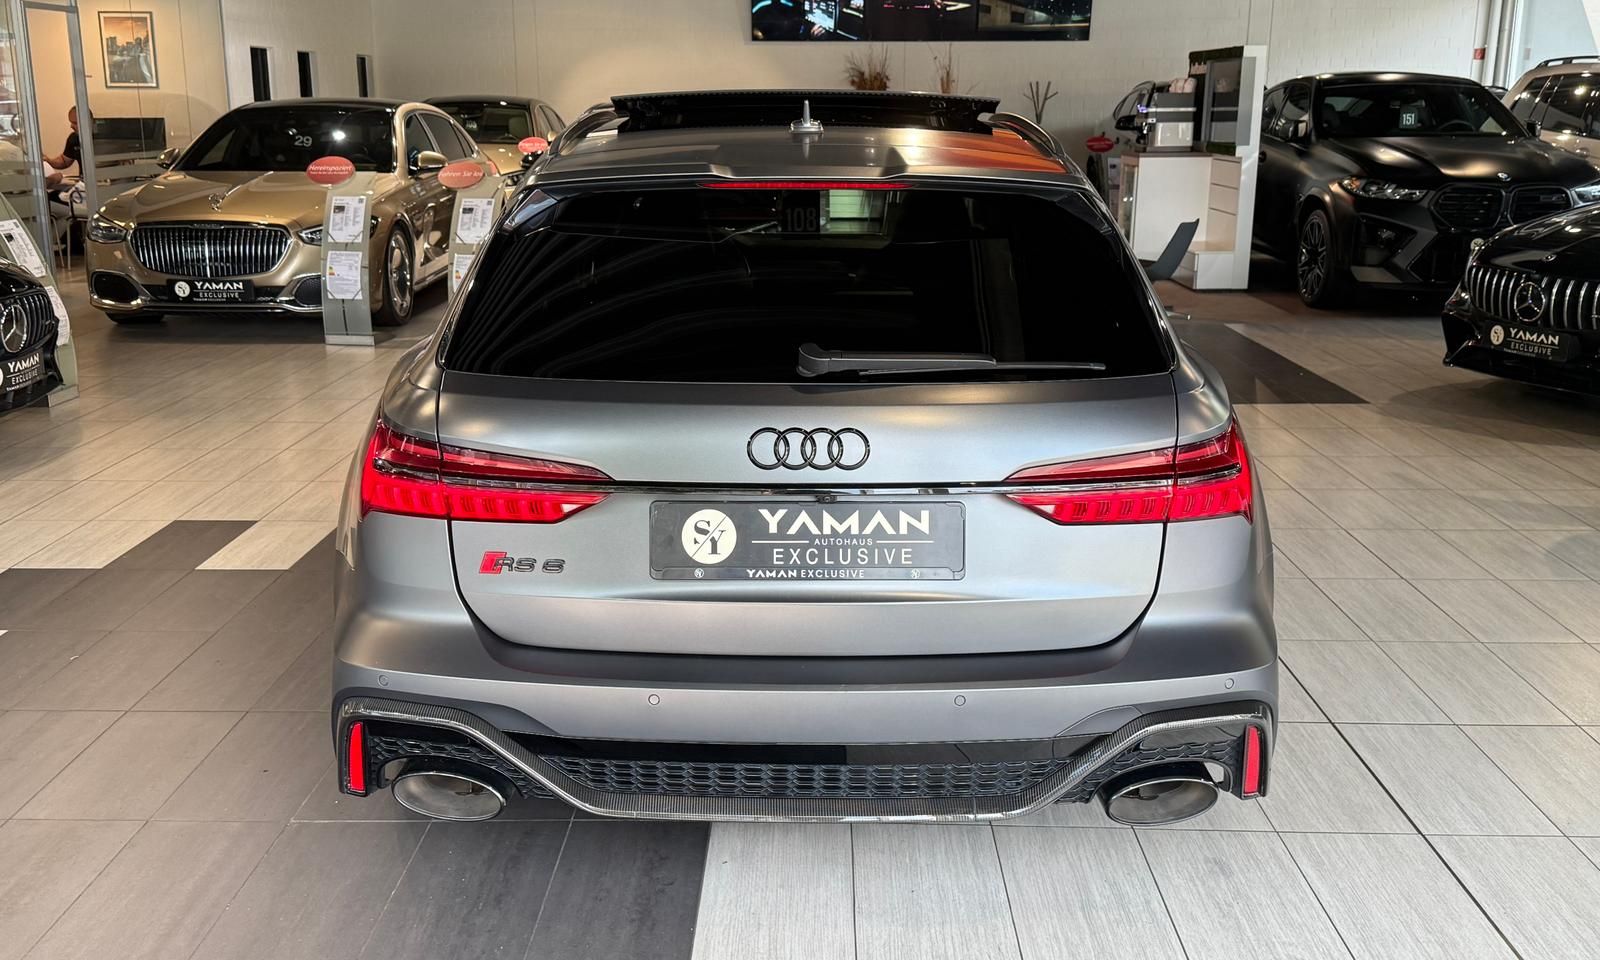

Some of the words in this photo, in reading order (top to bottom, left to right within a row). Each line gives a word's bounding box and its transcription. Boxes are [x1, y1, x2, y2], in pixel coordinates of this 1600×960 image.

[1402, 113, 1415, 125] 151
[294, 135, 313, 147] 29
[785, 207, 817, 232] 108
[194, 281, 244, 290] YAMAN
[1509, 327, 1560, 345] YAMAN
[1510, 342, 1552, 356] EXCLUSIVE
[7, 352, 40, 373] YAMAN
[758, 508, 930, 535] YAMAN
[814, 538, 873, 546] AUTOHAUS
[488, 555, 537, 572] RS
[773, 548, 913, 565] EXCLUSIVE
[746, 569, 798, 578] YAMAN
[801, 569, 865, 578] EXCLUSIVE
